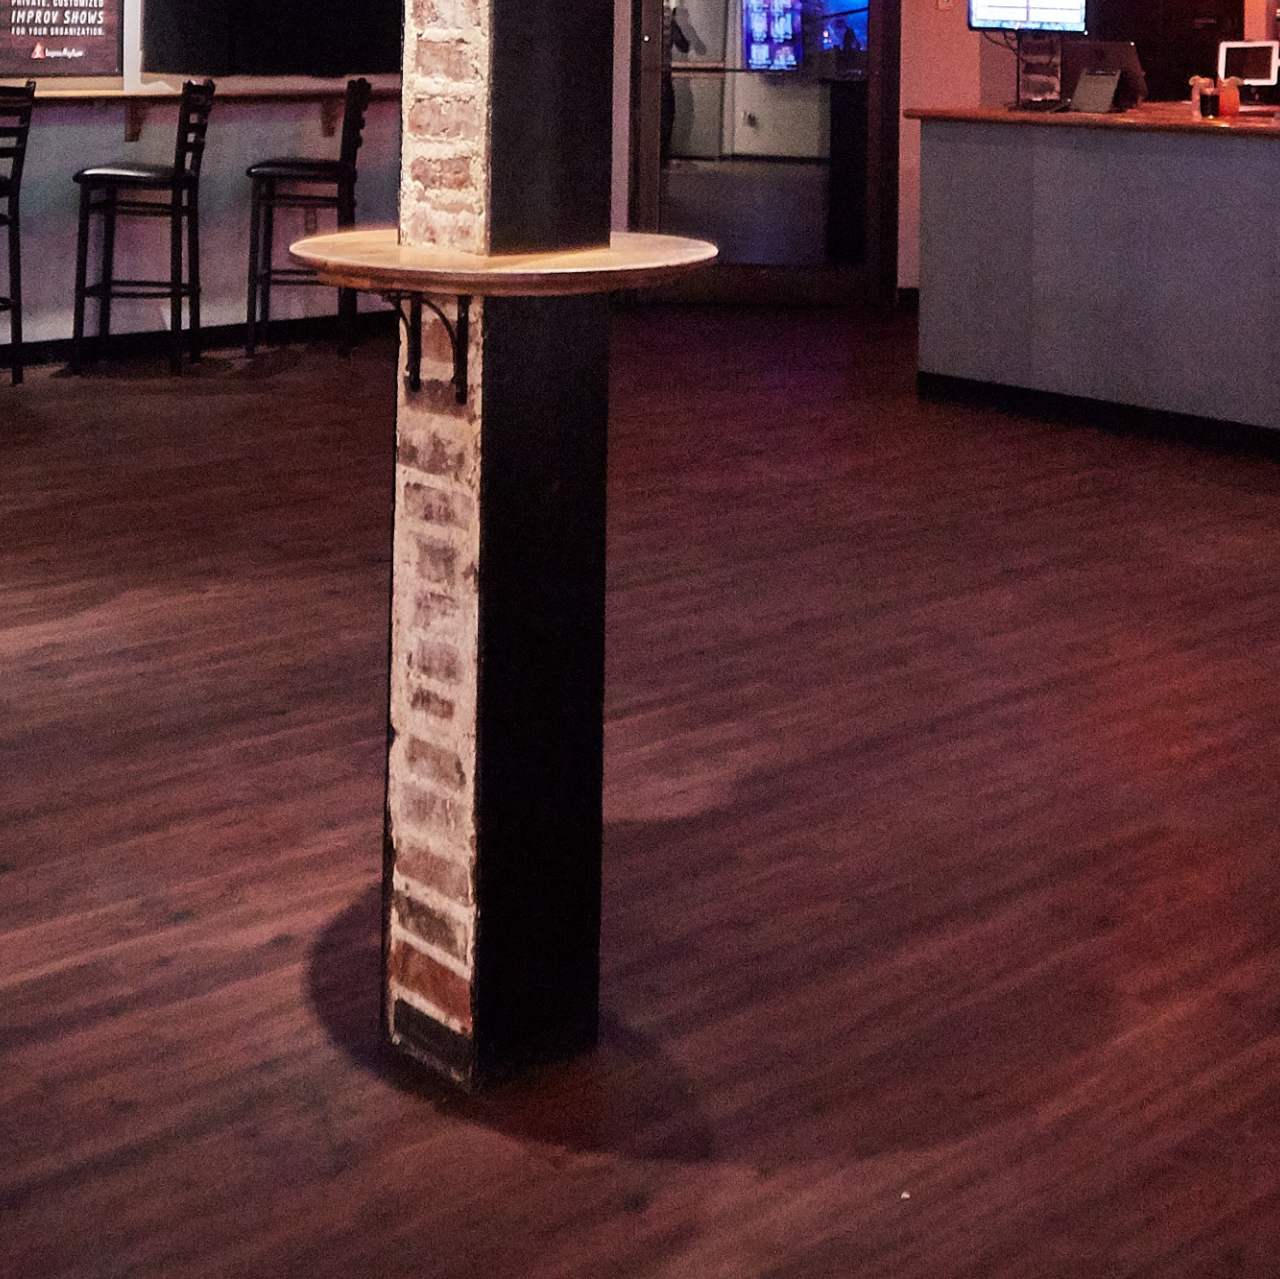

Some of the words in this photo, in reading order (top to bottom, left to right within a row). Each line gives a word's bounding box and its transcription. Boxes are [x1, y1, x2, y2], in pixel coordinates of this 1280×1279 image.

[11, 10, 59, 24] IMPROV
[64, 10, 104, 24] SHOWS
[11, 26, 26, 35] FOR
[28, 27, 48, 35] YOUR
